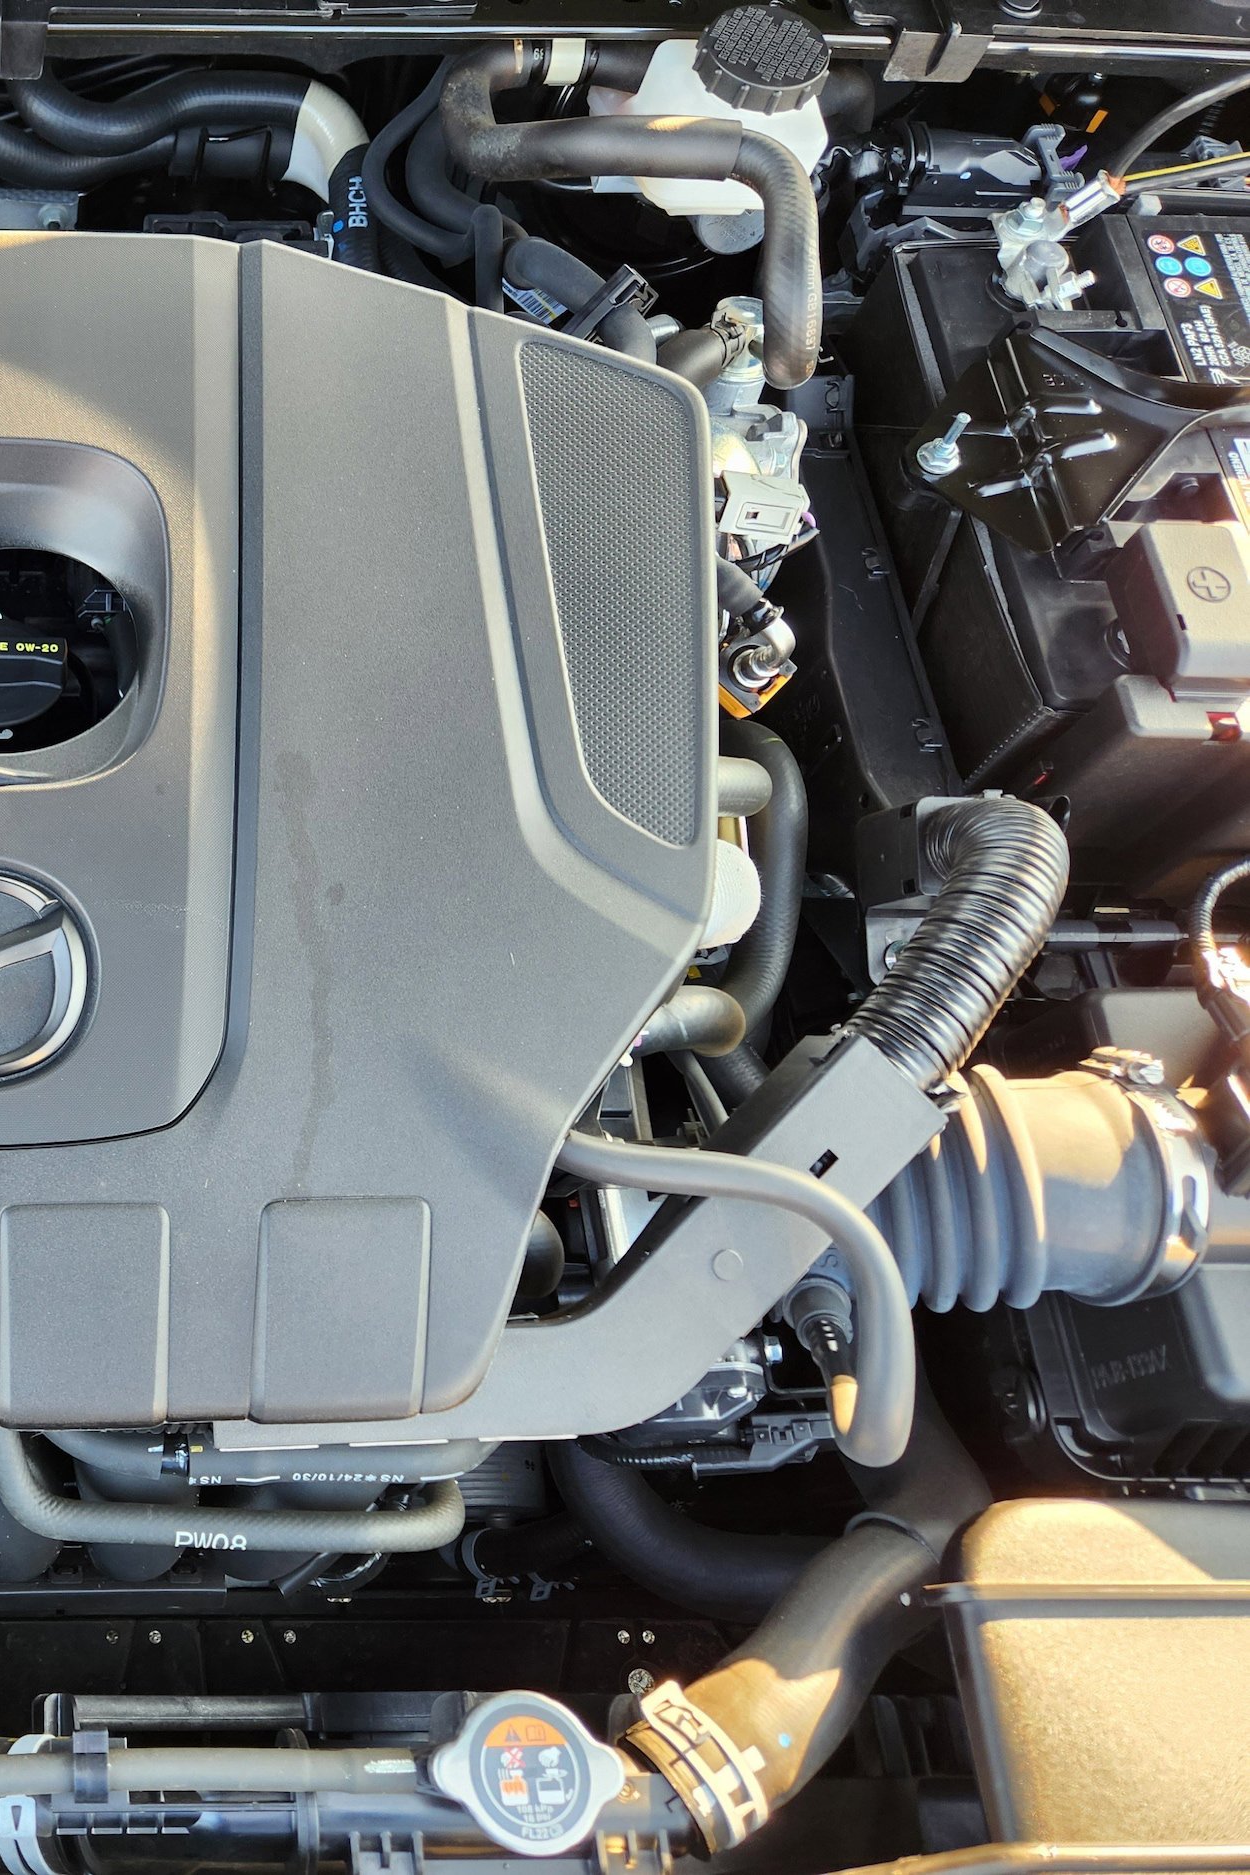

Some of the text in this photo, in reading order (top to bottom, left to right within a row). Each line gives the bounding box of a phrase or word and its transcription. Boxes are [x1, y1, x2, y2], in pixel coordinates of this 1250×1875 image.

[1193, 319, 1207, 333] AH
[1190, 346, 1207, 367] LN2
[1203, 344, 1220, 367] 20HR
[15, 642, 59, 653] 0W-20
